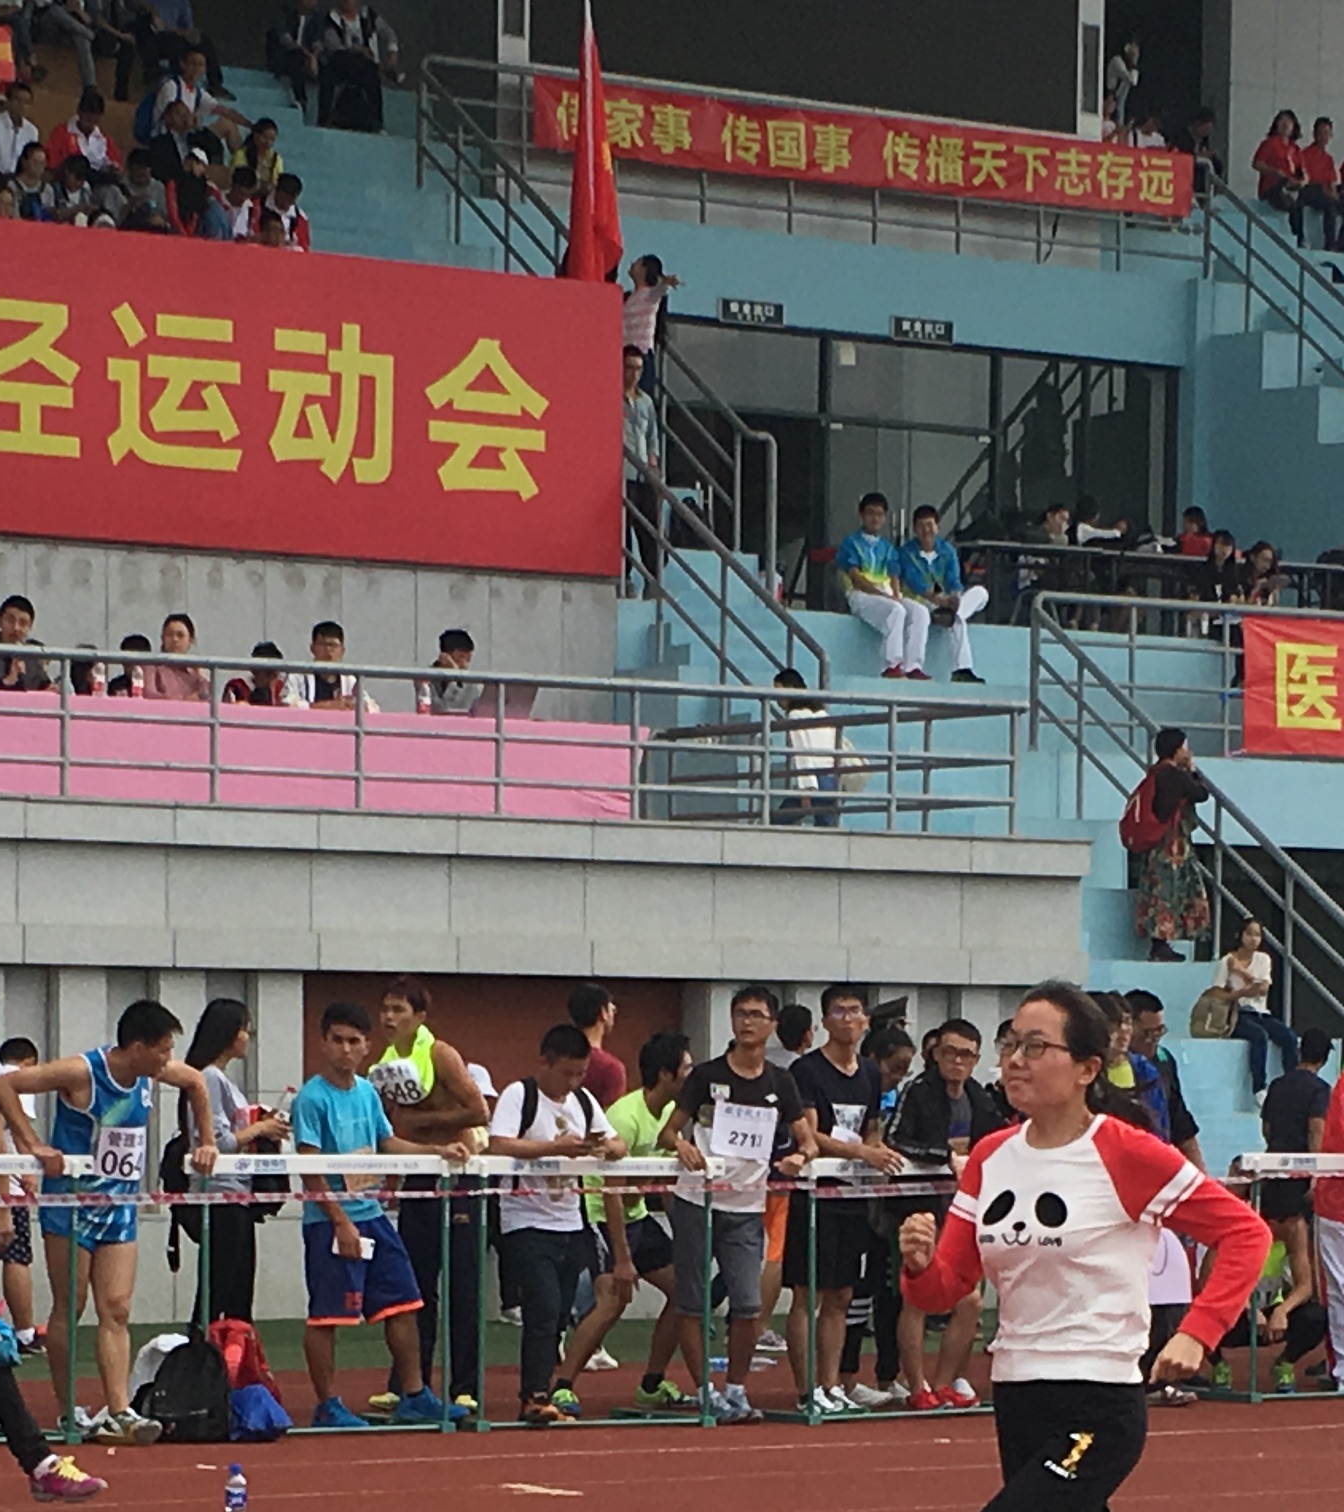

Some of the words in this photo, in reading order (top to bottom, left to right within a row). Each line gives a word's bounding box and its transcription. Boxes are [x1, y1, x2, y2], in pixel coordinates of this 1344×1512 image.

[722, 114, 854, 174] 传国事
[882, 131, 1177, 206] 传播天下志存远
